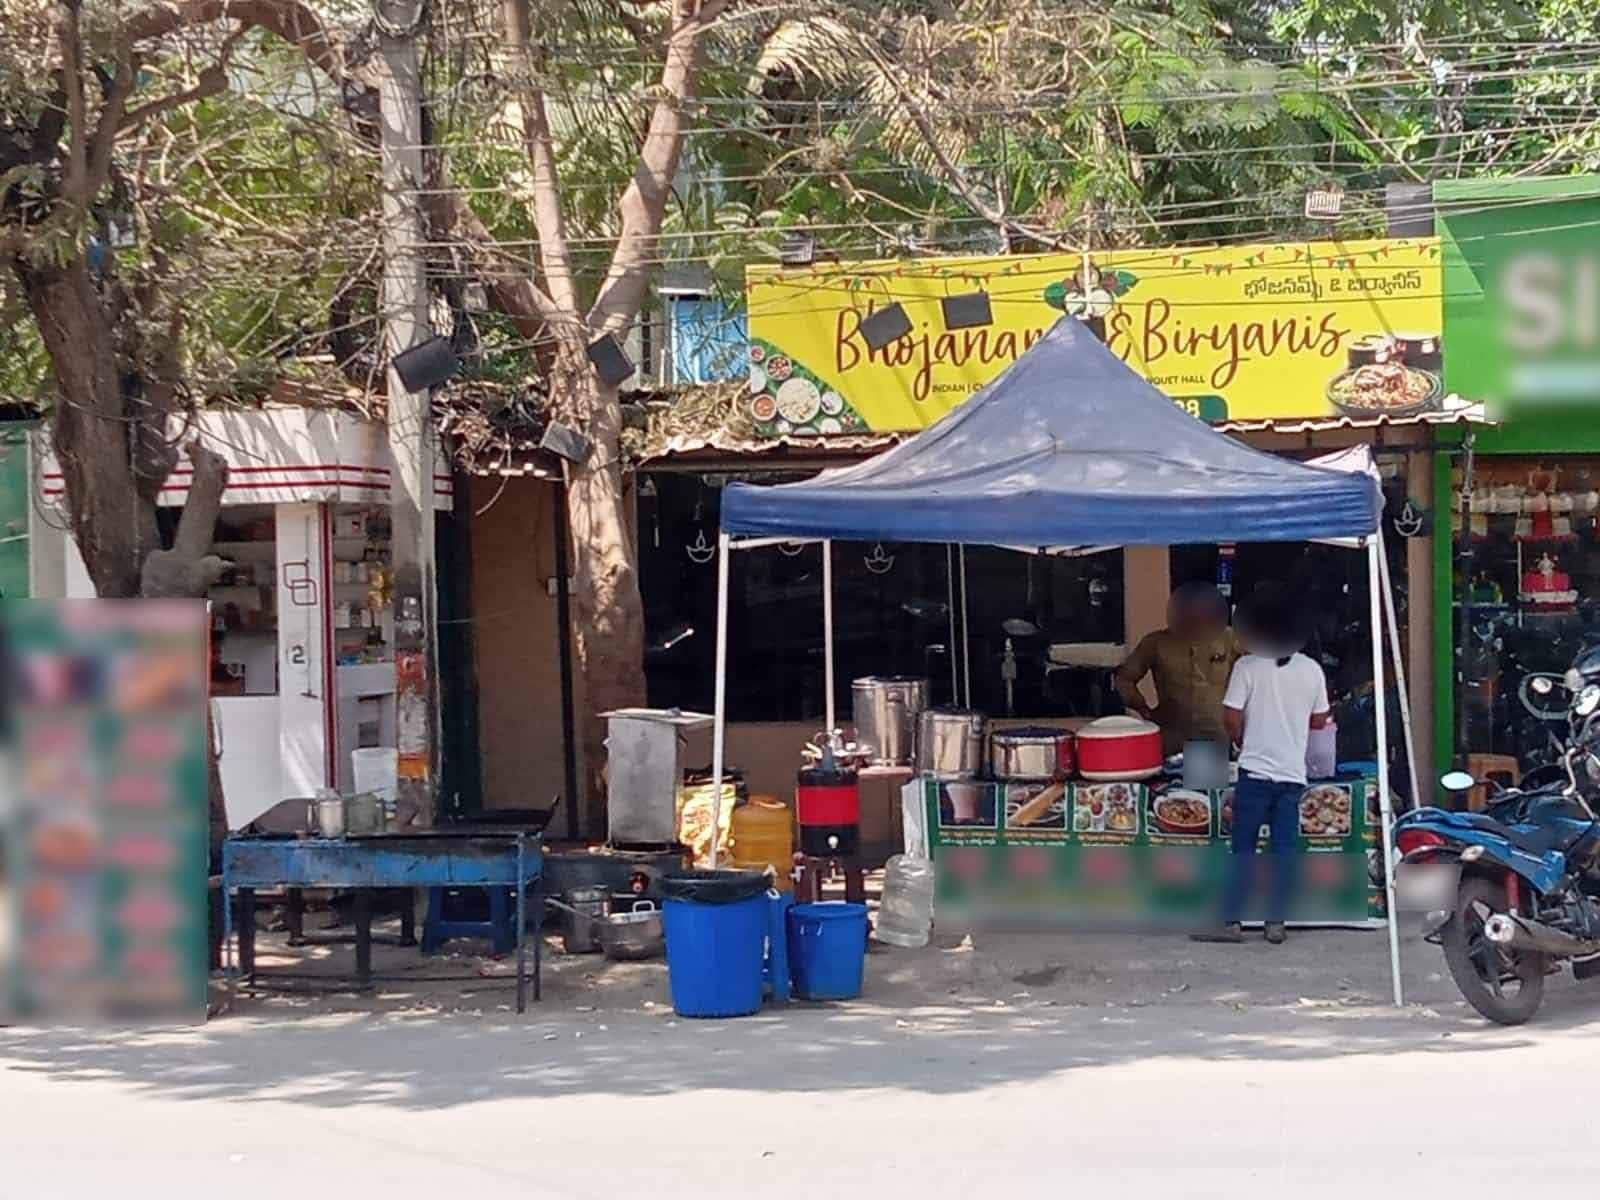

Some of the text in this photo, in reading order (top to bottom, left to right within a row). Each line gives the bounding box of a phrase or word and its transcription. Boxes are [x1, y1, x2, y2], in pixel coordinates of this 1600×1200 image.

[1144, 298, 1351, 389] Biryanis
[932, 383, 966, 393] INDIAN
[1181, 375, 1206, 383] HALL
